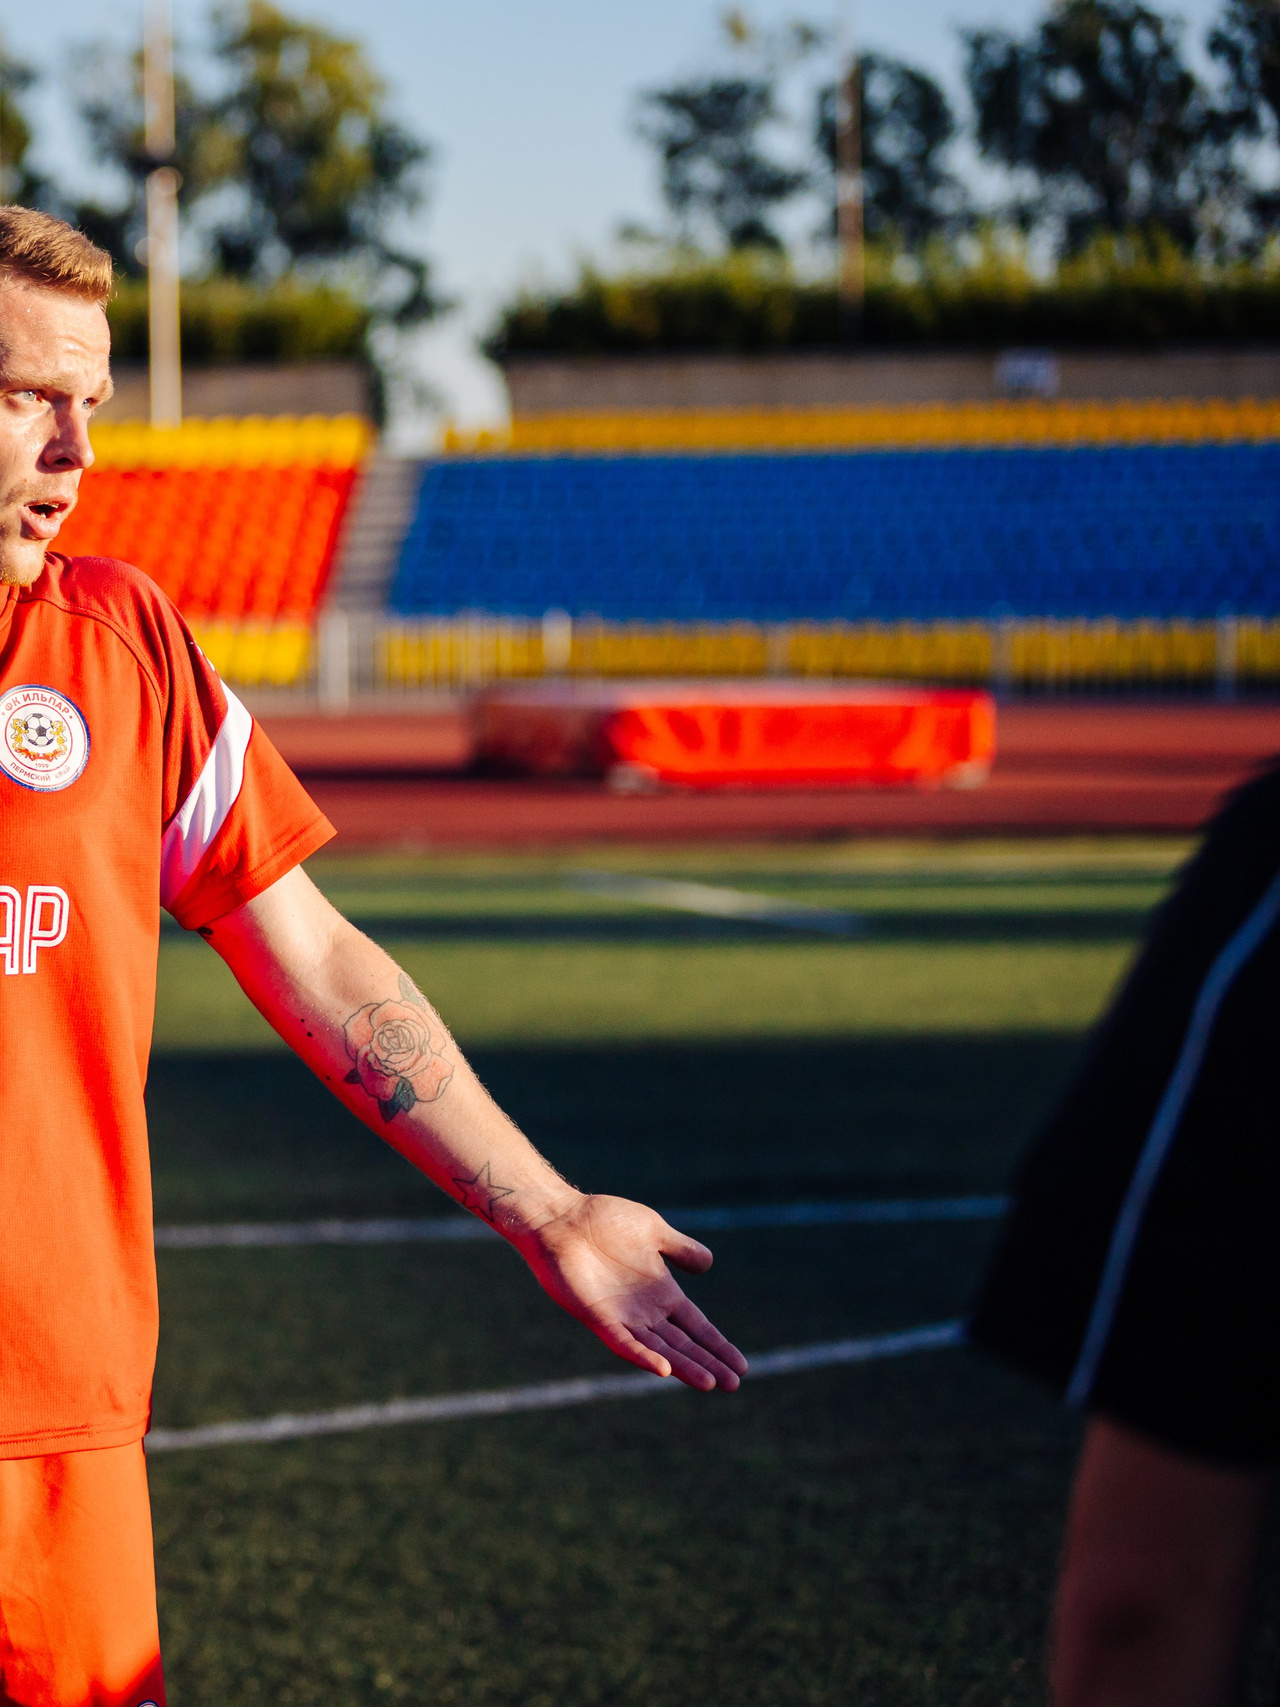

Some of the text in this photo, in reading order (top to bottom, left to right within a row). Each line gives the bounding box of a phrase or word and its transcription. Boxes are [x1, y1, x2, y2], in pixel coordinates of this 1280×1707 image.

[4, 692, 70, 715] ФК ИЛЬПАР
[10, 761, 71, 781] ПЕРМСКИЙ КРАЙ
